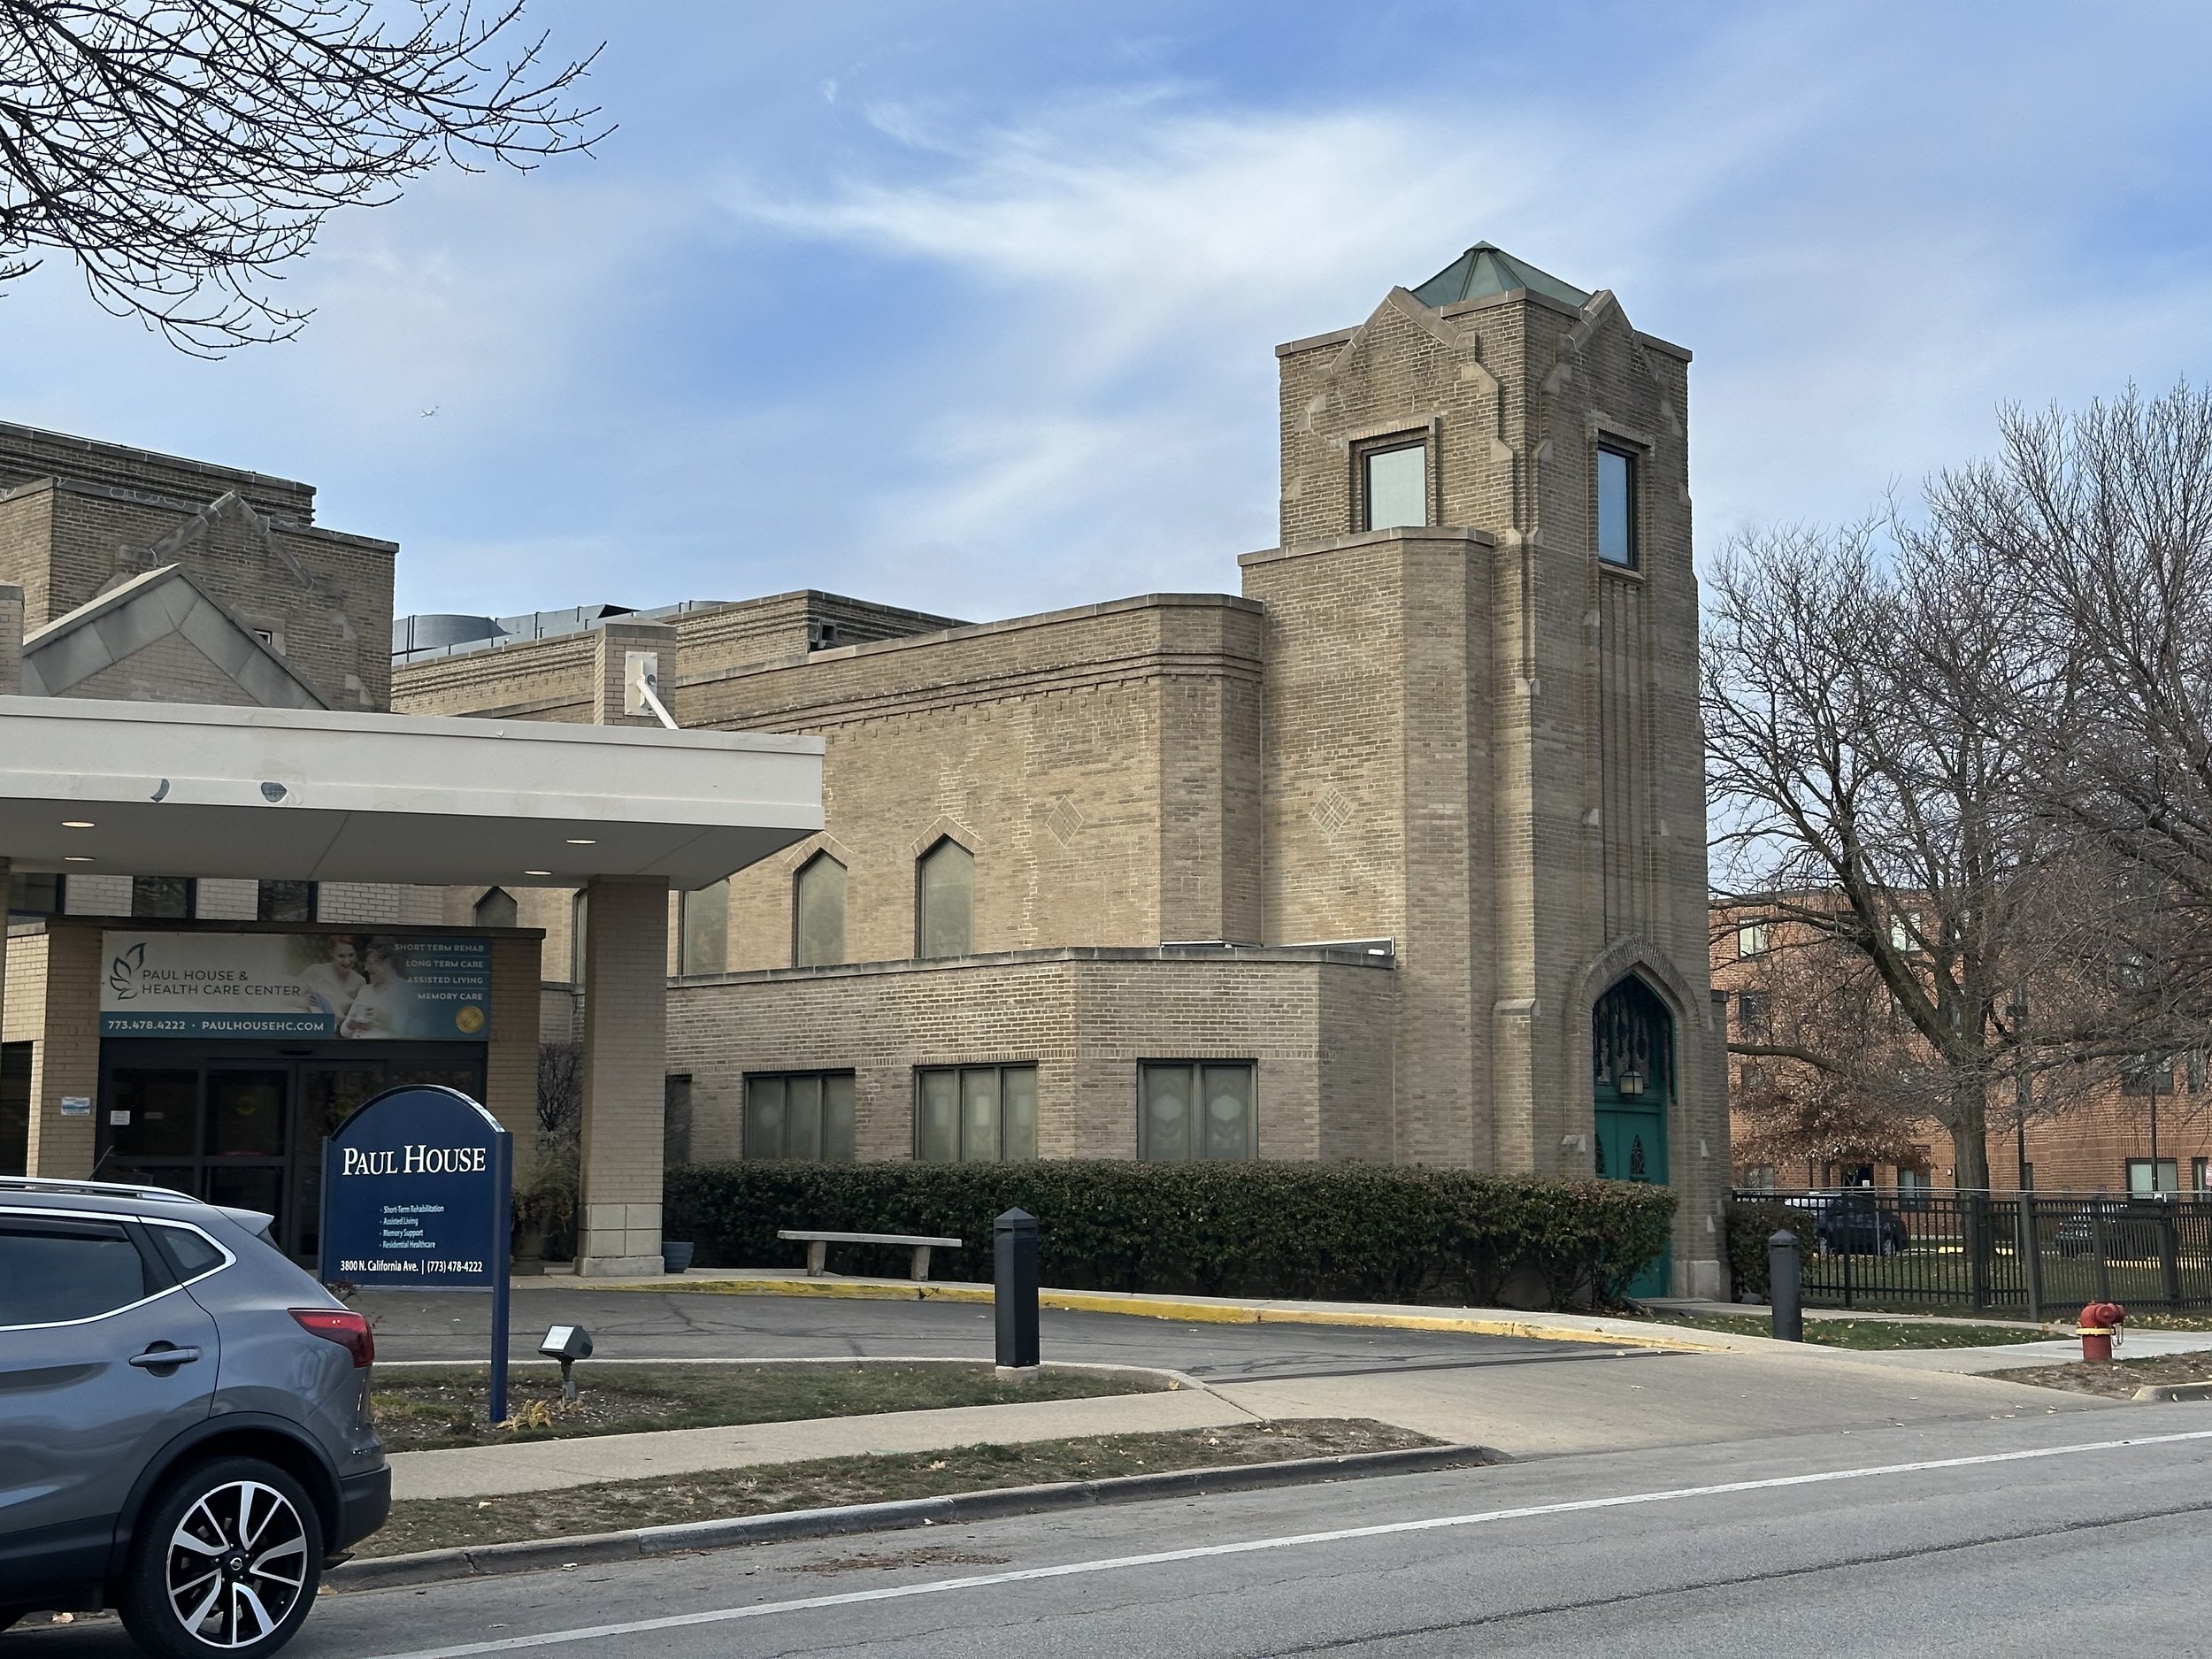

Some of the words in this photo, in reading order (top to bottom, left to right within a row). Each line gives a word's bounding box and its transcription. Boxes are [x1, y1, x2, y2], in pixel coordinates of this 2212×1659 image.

[142, 970, 180, 980] PAUL
[184, 970, 234, 981] HOUSE
[239, 971, 249, 981] &
[142, 984, 198, 995] HEALTH
[204, 984, 241, 995] CARE
[244, 985, 301, 996] CENTER
[108, 1020, 186, 1030] 773.478.4222
[202, 1021, 324, 1031] PAULHOUSEHC.COM
[342, 1148, 398, 1175] PAUL
[403, 1144, 486, 1173] HOUSE
[411, 1204, 445, 1213] Rehabilitation
[403, 1217, 419, 1226] Living
[383, 1229, 403, 1239] Memory
[403, 1228, 424, 1238] Support
[410, 1240, 436, 1248] Healthcare
[340, 1260, 358, 1271] 3800
[358, 1261, 366, 1271] N.
[367, 1260, 402, 1271] California
[403, 1261, 419, 1271] Ave.
[427, 1260, 446, 1273] (773)
[447, 1261, 483, 1272] 478-4222
